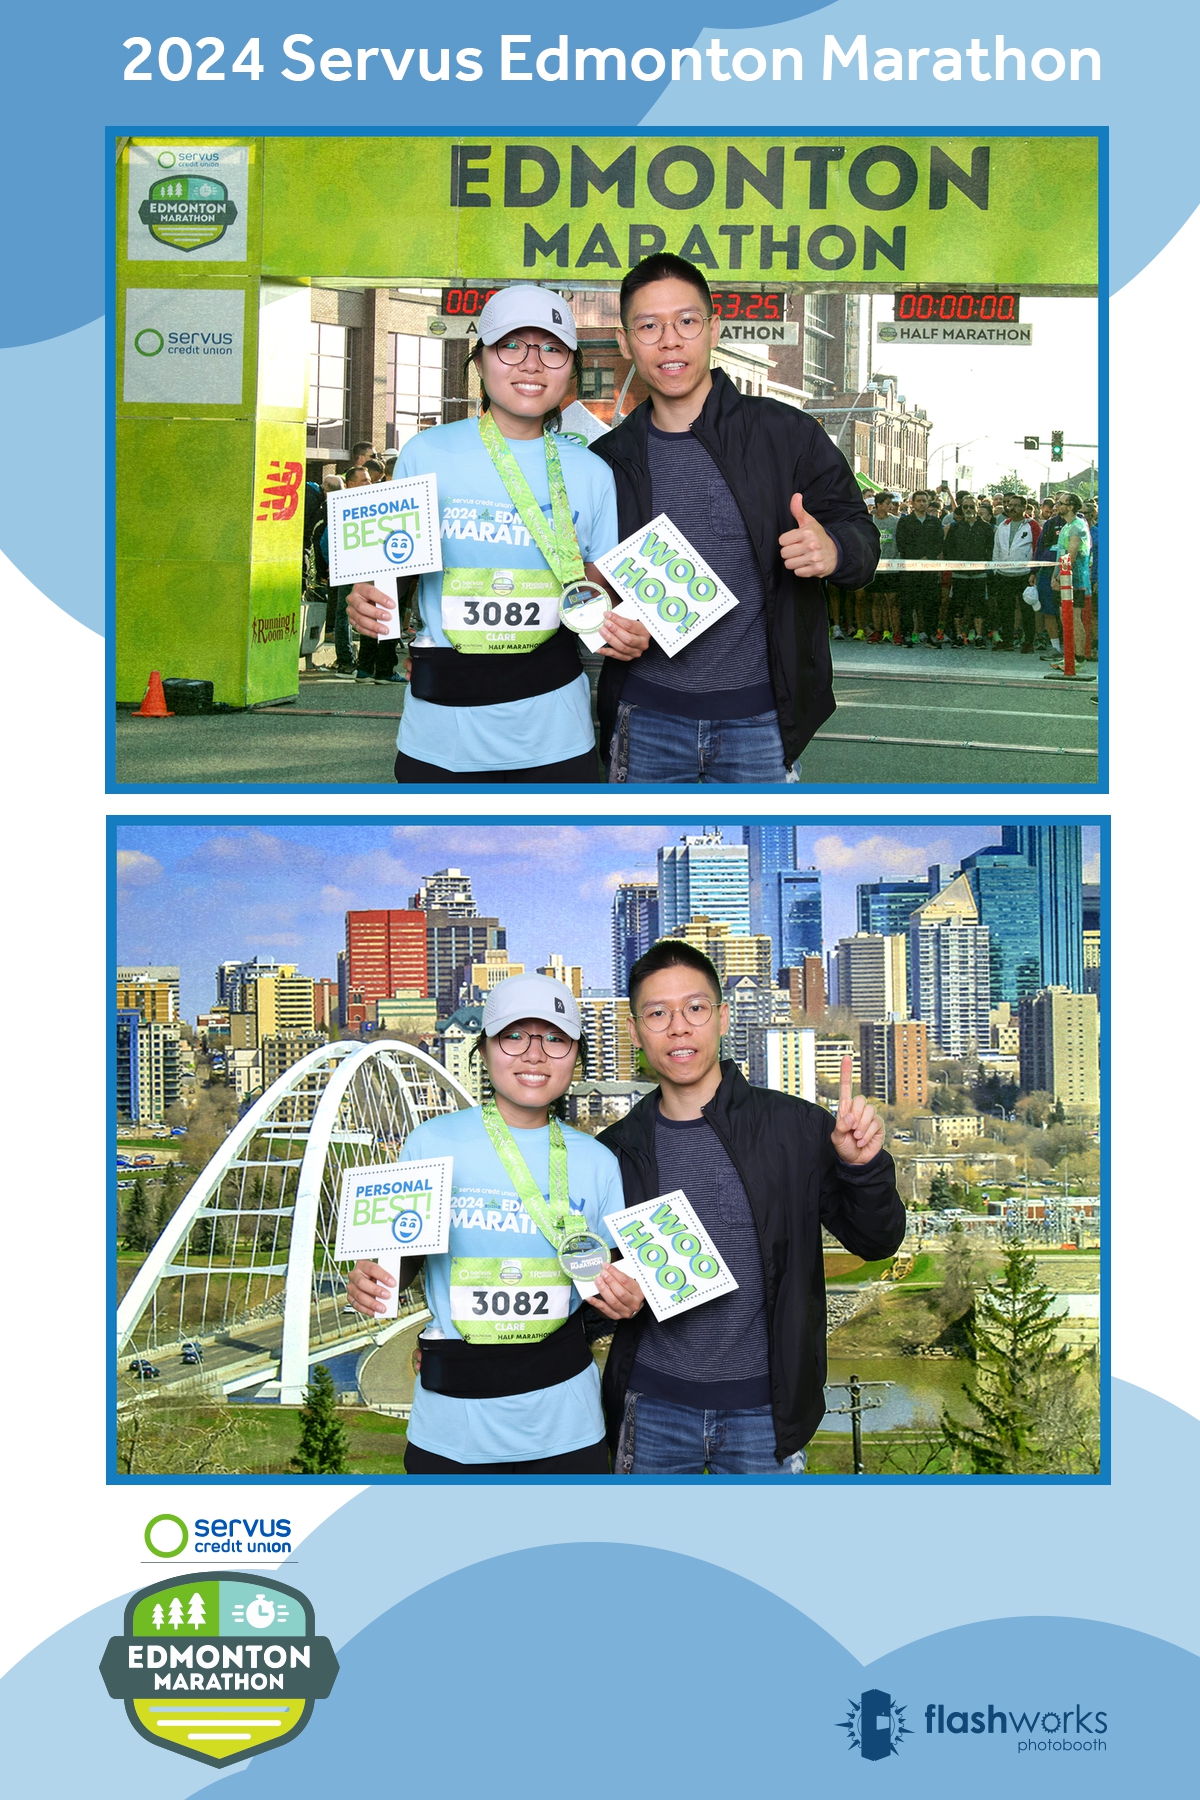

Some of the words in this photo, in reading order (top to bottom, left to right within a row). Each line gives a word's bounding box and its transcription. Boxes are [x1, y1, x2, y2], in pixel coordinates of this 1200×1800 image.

[178, 152, 219, 161] servus
[450, 144, 990, 211] EDMONTON
[149, 203, 227, 213] EDMONTON
[160, 214, 215, 222] MARATHON
[523, 223, 906, 271] MARATHON
[168, 331, 233, 345] servus
[720, 326, 784, 340] ATHON
[900, 328, 939, 340] HALF
[943, 329, 1031, 341] MARATHON
[168, 345, 200, 355] credit
[203, 347, 233, 355] union
[343, 497, 419, 522] PERSONAL
[475, 499, 494, 508] credit
[443, 507, 478, 520] 2024
[495, 509, 523, 525] EDM
[343, 510, 421, 551] BEST!
[639, 532, 717, 602] WOO
[611, 557, 700, 633] HOO!
[463, 601, 540, 627] 3082
[486, 633, 516, 642] CLARE
[356, 1178, 433, 1198] PERSONAL
[481, 1188, 500, 1196] credit
[501, 1190, 519, 1198] union
[353, 1192, 432, 1227] BEST!
[450, 1196, 485, 1209] 2024
[649, 1203, 720, 1279] WOO
[617, 1220, 697, 1303] HOO!
[472, 1291, 549, 1316] 3082
[495, 1323, 525, 1332] CLARE
